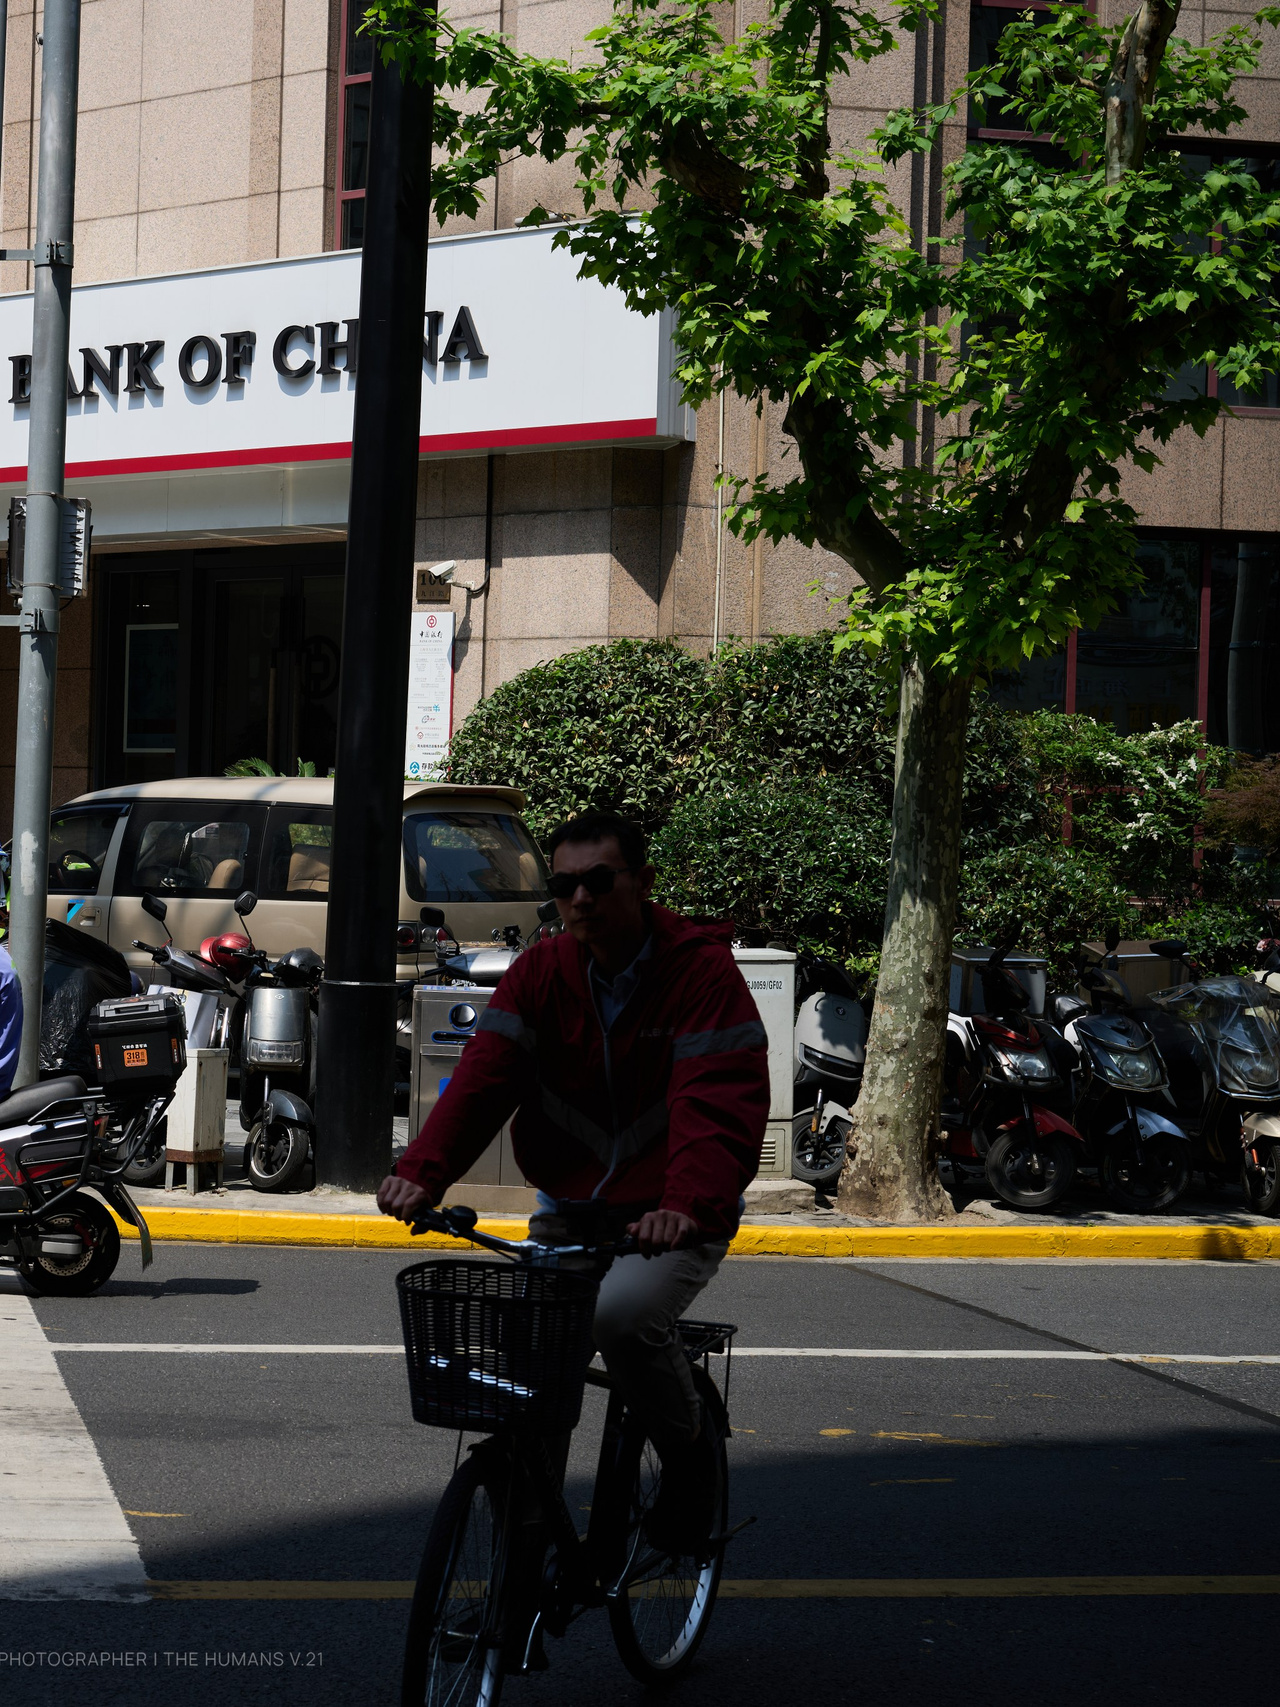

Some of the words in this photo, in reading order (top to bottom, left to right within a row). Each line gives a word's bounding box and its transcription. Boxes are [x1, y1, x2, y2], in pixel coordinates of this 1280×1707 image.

[8, 340, 165, 404] BNK
[178, 331, 256, 388] OF
[126, 1052, 140, 1060] 318
